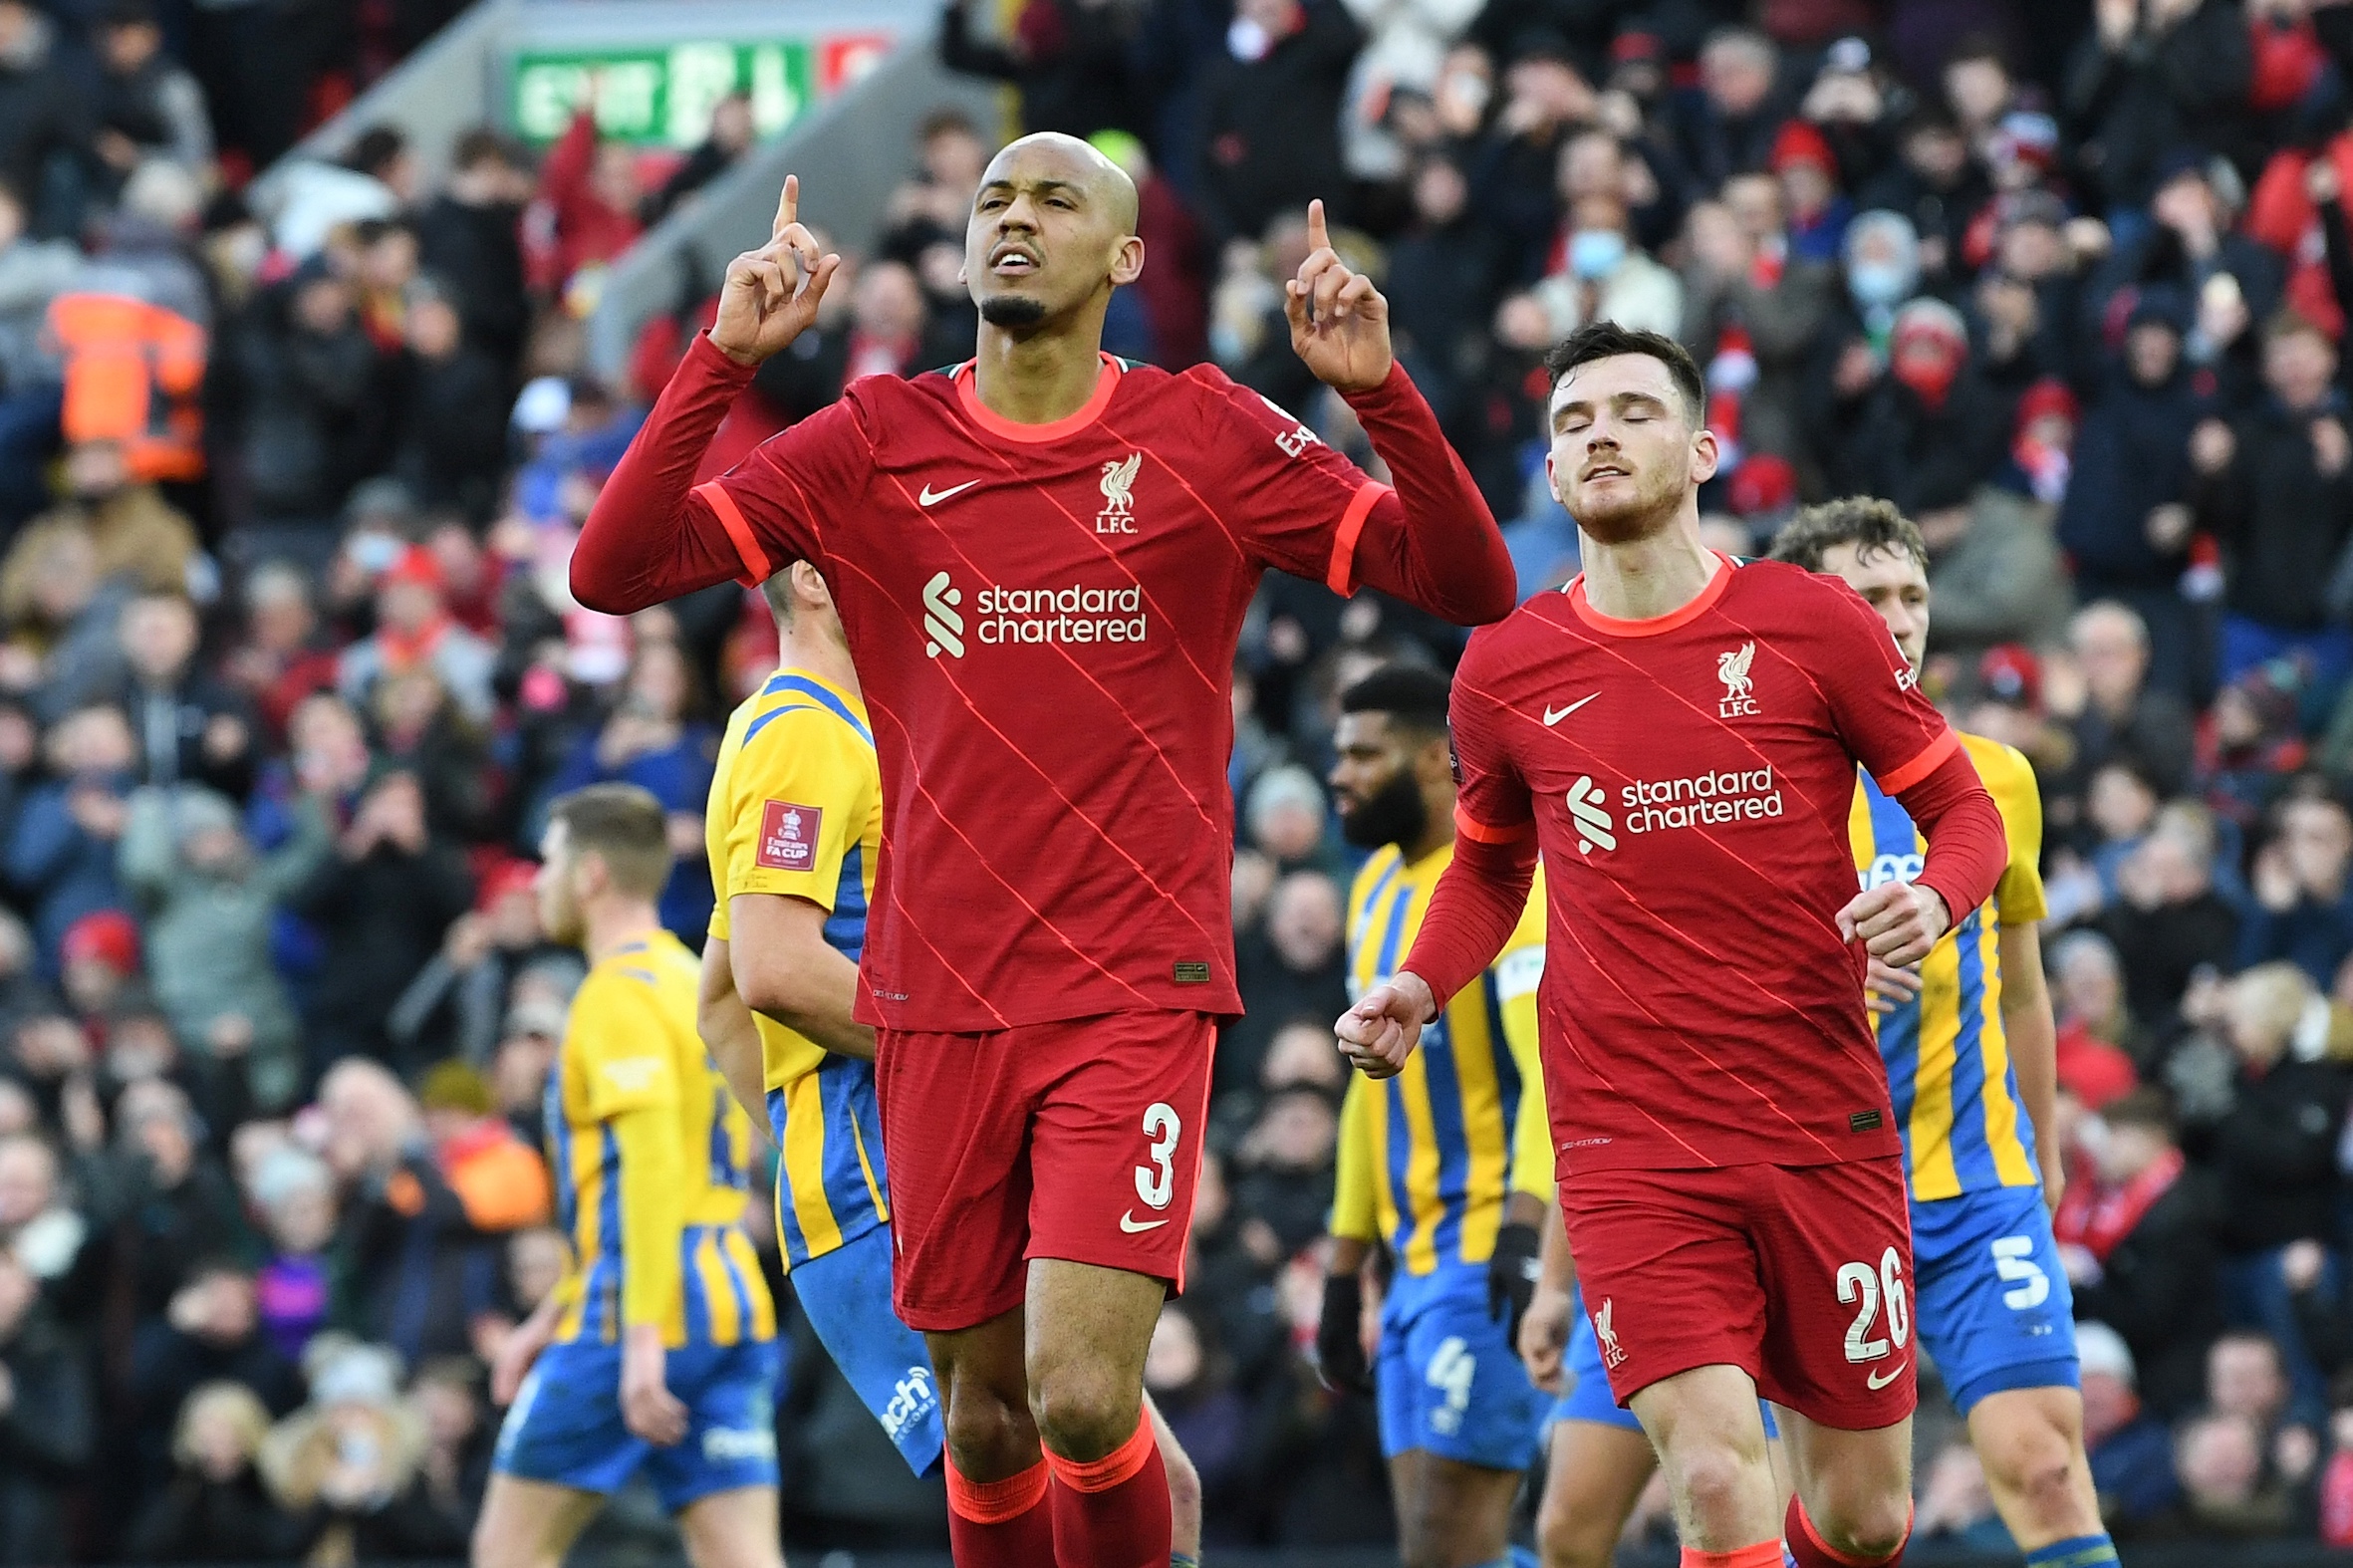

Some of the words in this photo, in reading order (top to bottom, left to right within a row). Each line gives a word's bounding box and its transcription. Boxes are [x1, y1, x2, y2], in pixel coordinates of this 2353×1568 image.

[977, 584, 1142, 614] standard
[977, 613, 1147, 644] chartered
[1621, 764, 1772, 807] standard
[1626, 790, 1783, 834] chartered
[765, 845, 781, 857] FA
[782, 848, 808, 859] CUP
[1135, 1102, 1182, 1211] 3
[1990, 1235, 2050, 1311] 5
[1836, 1245, 1910, 1364] 26
[1426, 1335, 1476, 1413] 4
